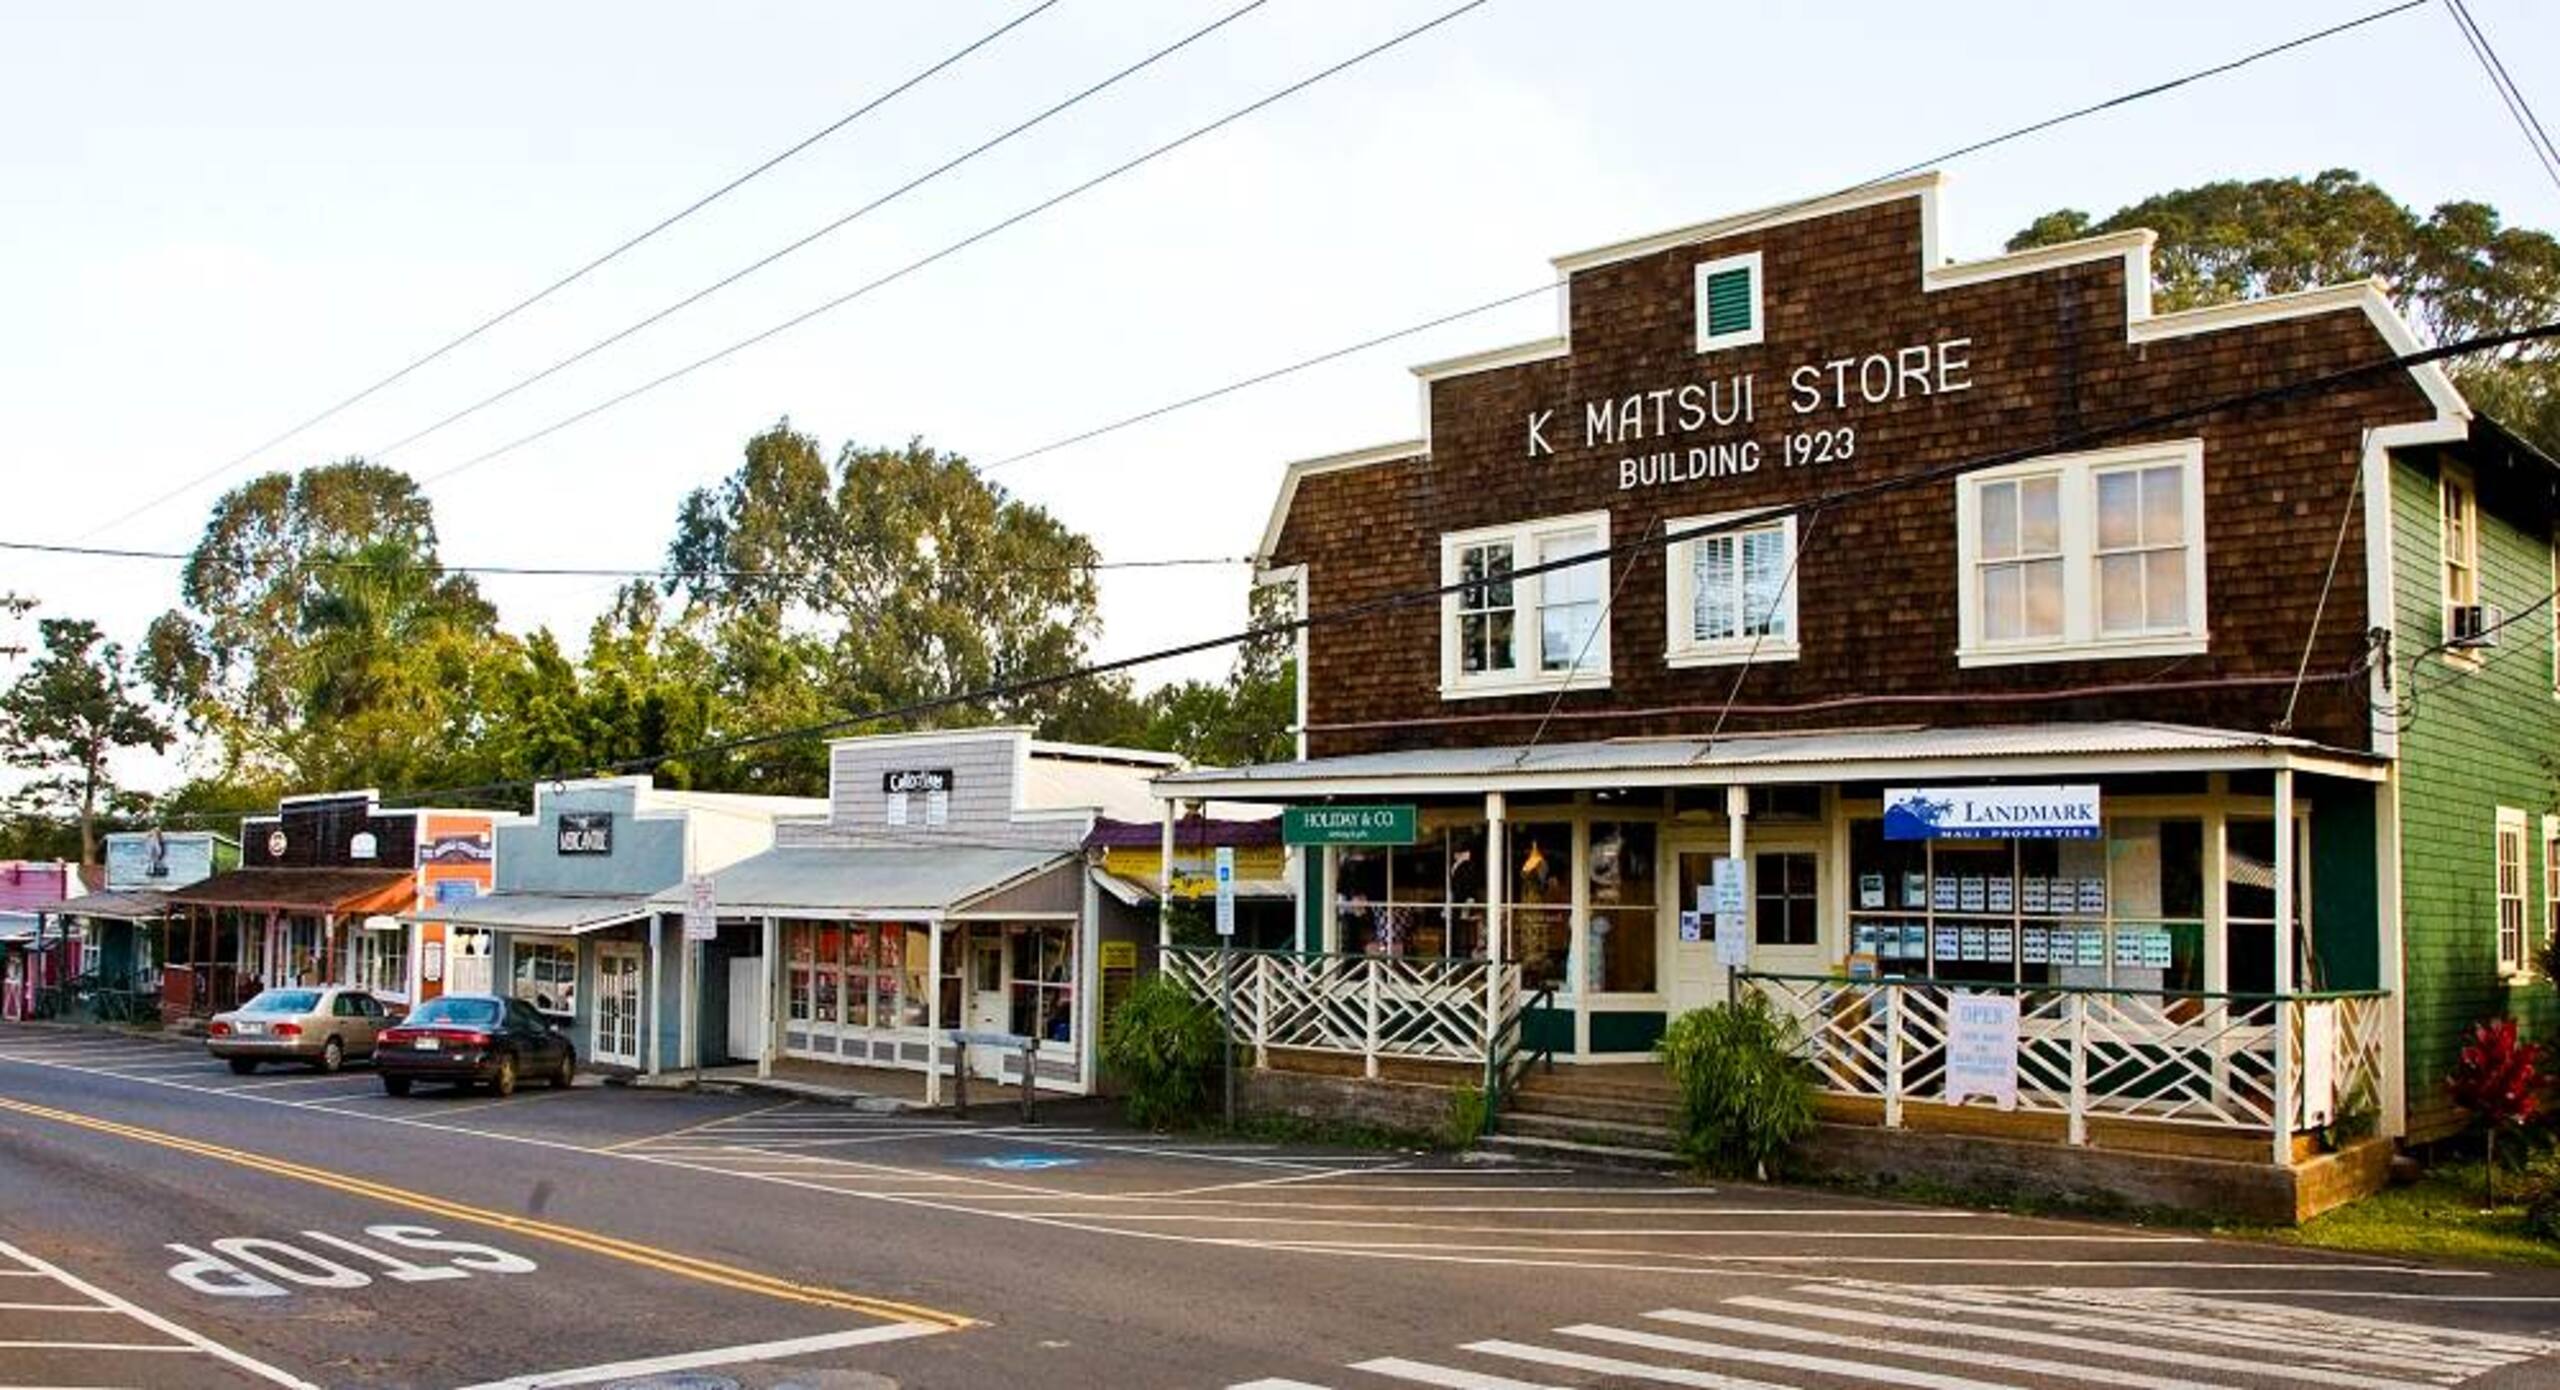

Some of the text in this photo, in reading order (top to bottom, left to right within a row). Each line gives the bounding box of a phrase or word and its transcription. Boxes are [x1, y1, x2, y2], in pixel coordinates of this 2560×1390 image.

[1528, 337, 1974, 457] K MATSUI STORE
[1618, 427, 1856, 490] BUILDING 1923
[1304, 811, 1360, 828] HOLIDAY
[1361, 811, 1373, 827] &
[1964, 801, 2094, 823] LANDMARK
[1941, 827, 2091, 838] MAUI PROPERTIES
[1961, 1005, 2003, 1025] OPEN
[166, 1225, 538, 1297] STOP
